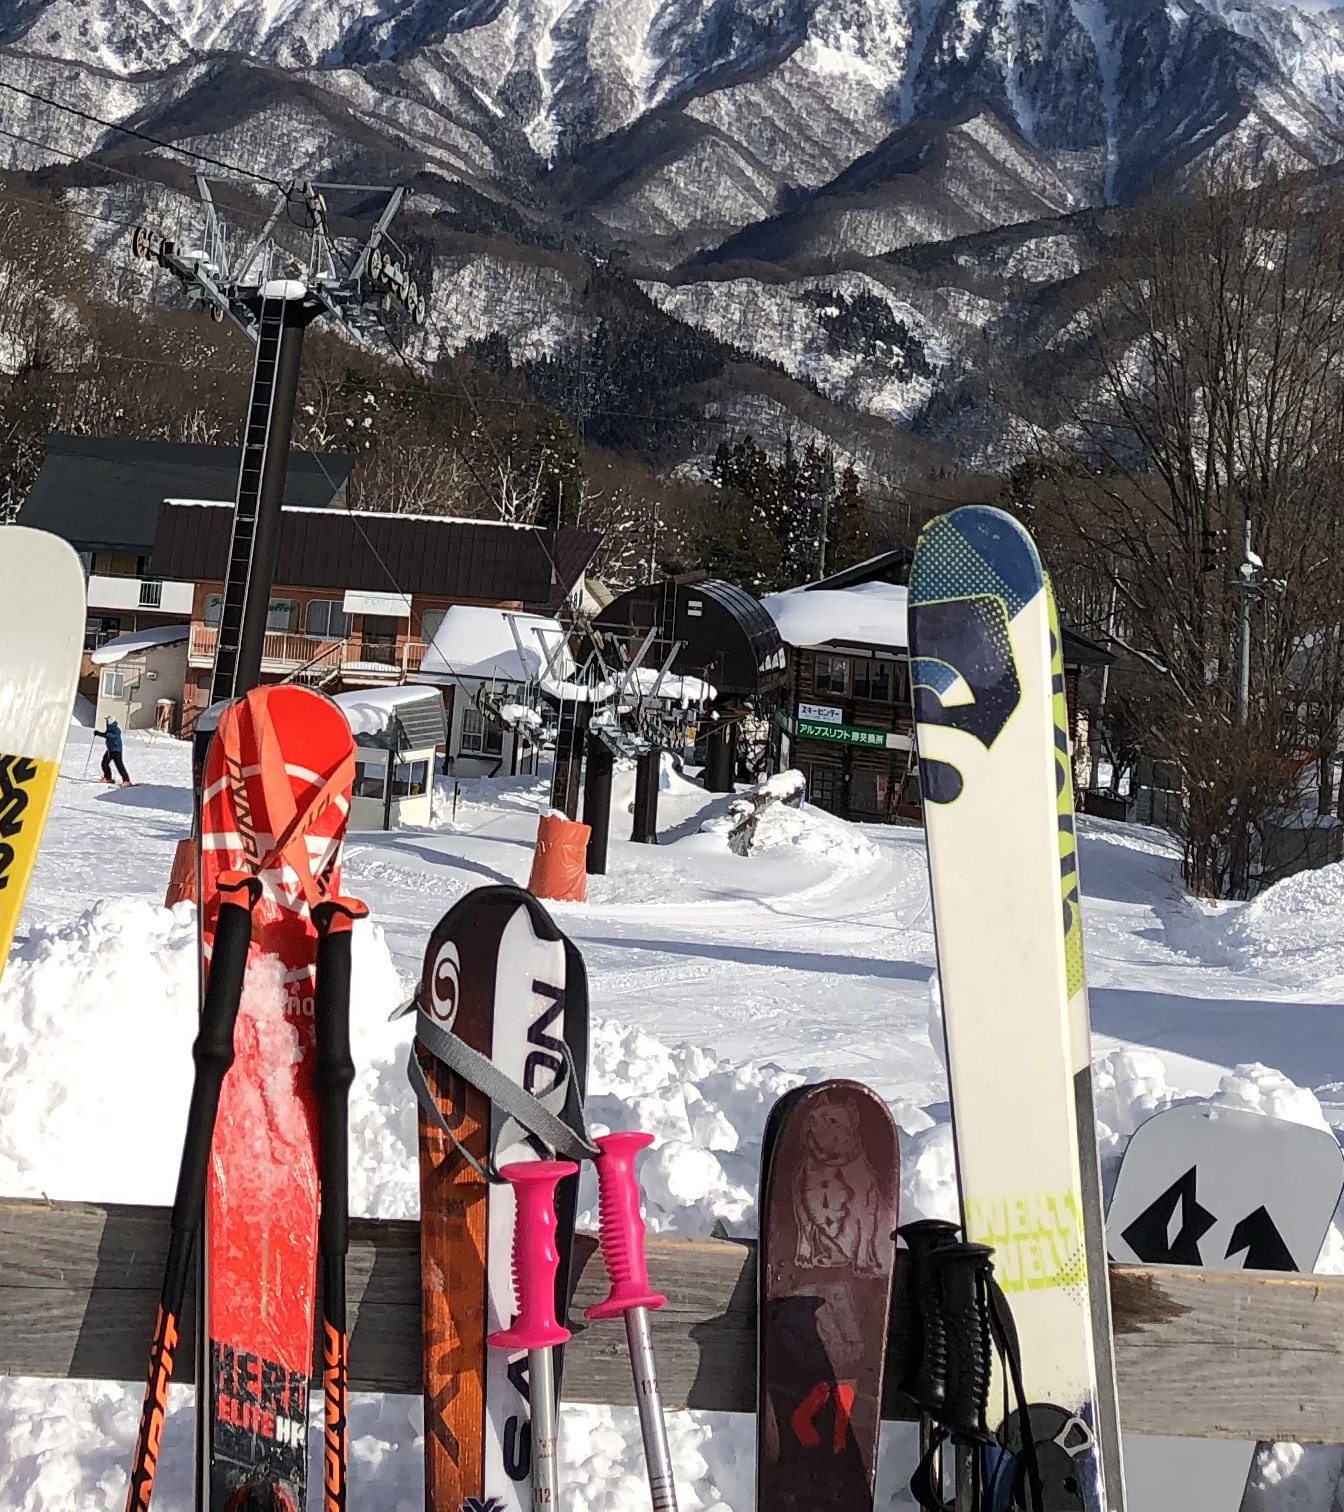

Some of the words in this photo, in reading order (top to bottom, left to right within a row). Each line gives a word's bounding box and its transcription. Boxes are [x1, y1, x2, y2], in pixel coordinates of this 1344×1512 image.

[268, 602, 295, 613] offee
[801, 705, 841, 717] スキーセンター
[217, 1393, 275, 1439] ELITE
